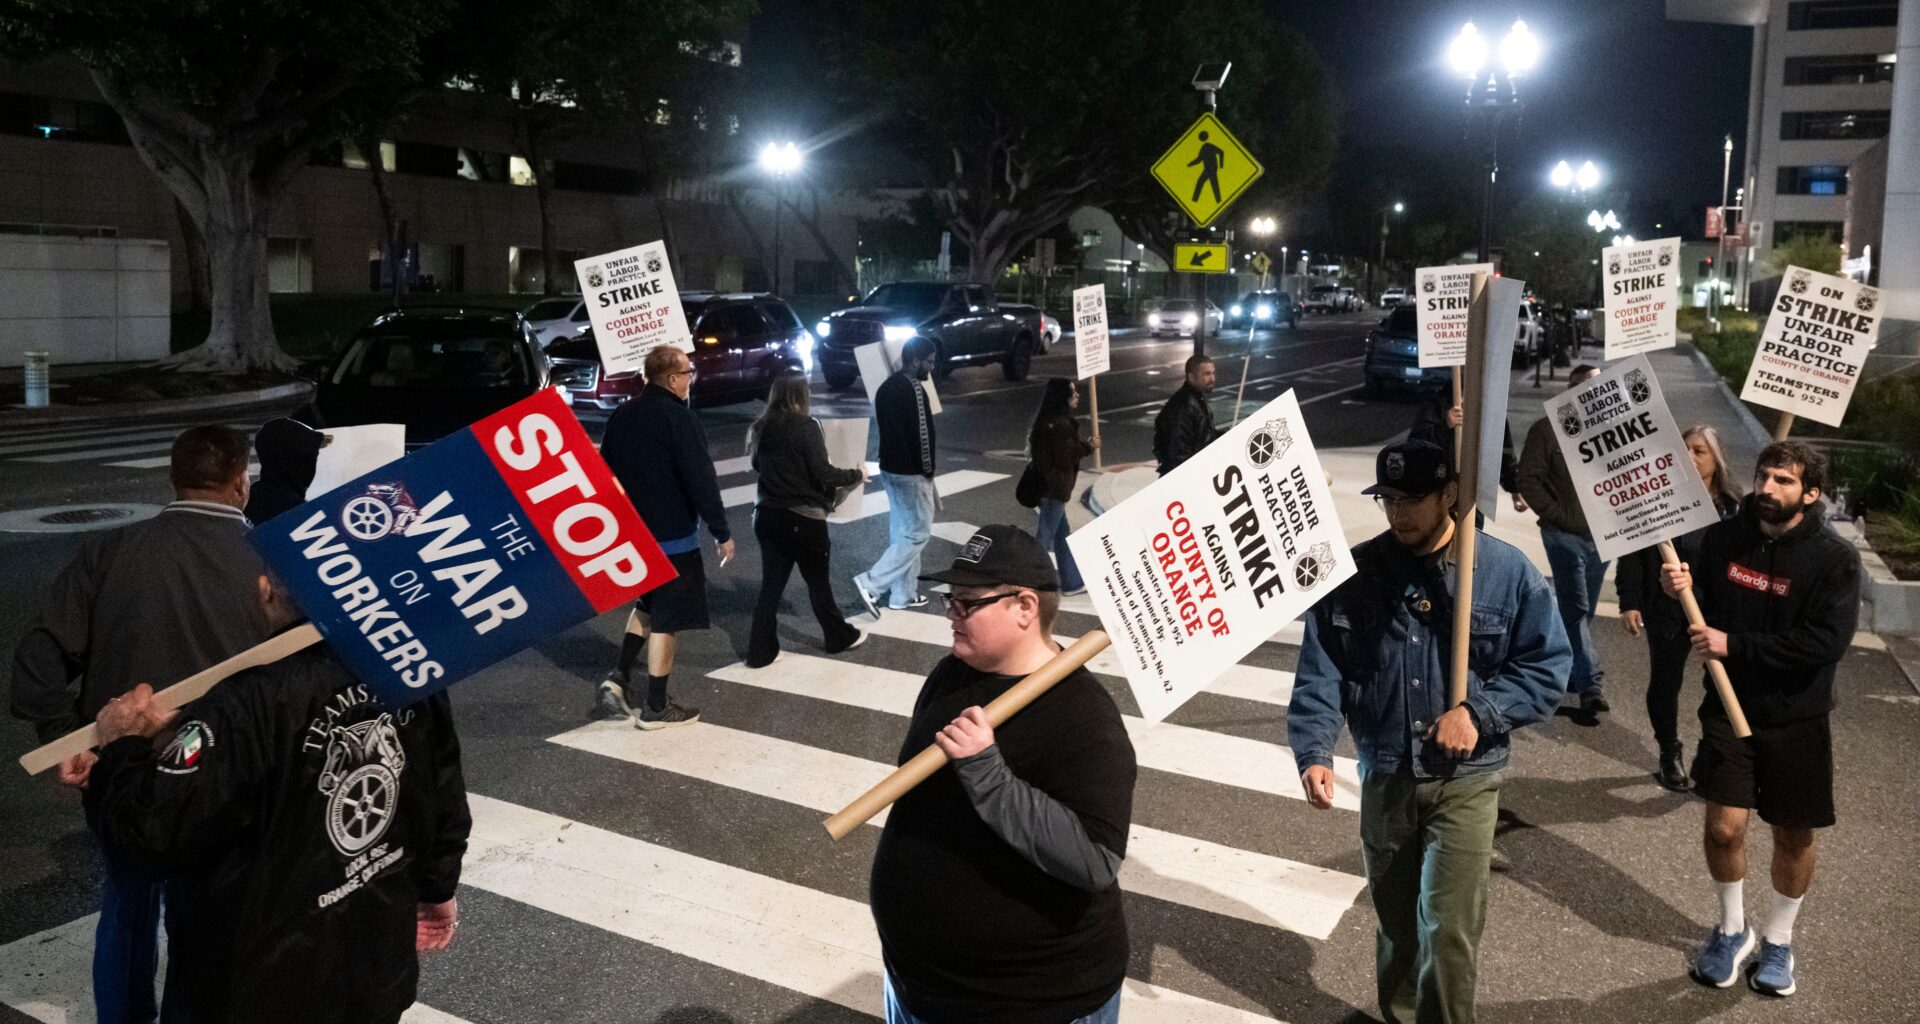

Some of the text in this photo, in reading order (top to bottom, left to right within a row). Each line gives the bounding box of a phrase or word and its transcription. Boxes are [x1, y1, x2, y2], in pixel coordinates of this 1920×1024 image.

[606, 256, 639, 269] UNFAIR
[1624, 264, 1656, 274] PRACTICE
[1628, 250, 1652, 259] UNFAIR
[1629, 258, 1650, 266] LABOR
[607, 272, 646, 286] PRACTICE
[610, 265, 640, 277] LABOR
[1614, 273, 1666, 296] STRIKE
[598, 279, 663, 308] STRIKE
[1428, 296, 1470, 311] STRIK
[1626, 294, 1652, 304] AGAINST
[1820, 287, 1844, 300] ON
[606, 306, 670, 331] COUNTY OF
[620, 302, 651, 316] AGAINST
[1079, 312, 1102, 328] STRIKE
[1614, 302, 1666, 319] COUNTY OF
[1621, 313, 1657, 328] ORANGE
[1776, 295, 1874, 334] STRIKE
[617, 319, 664, 339] ORANGE
[1434, 331, 1467, 339] ORANG
[1784, 316, 1855, 346] UNFAIR
[1779, 330, 1843, 358] LABOR
[1762, 341, 1858, 377] PRACTICE
[1762, 355, 1798, 369] COUNTY
[1813, 369, 1851, 385] ORANGE
[1578, 380, 1619, 404] UNFAIR
[1753, 380, 1824, 406] LOCAL 952
[1758, 370, 1840, 399] TEAMSTERS
[1584, 402, 1631, 429] PRACTICE
[1586, 393, 1622, 415] LABOR
[1578, 412, 1658, 464] STRIKE
[1593, 453, 1674, 497] COUNTY OF
[1606, 448, 1646, 473] AGAINST
[493, 412, 649, 588] STOP
[1290, 465, 1319, 531] UNFAIR
[1609, 474, 1671, 507] ORANGE
[1615, 489, 1674, 516] Teamsters Local 952
[1258, 473, 1296, 560] PRACTICE
[1277, 477, 1304, 537] LABOR
[1626, 502, 1670, 522] Sanctioned By:
[490, 513, 536, 561] THE
[1213, 465, 1285, 609] STRIKE
[1604, 531, 1618, 541] Joint
[1620, 523, 1640, 534] Council
[1648, 509, 1680, 524] Teamsters
[405, 490, 529, 636] WAR
[1166, 501, 1230, 639] COUNTY OF
[1202, 523, 1237, 592] AGAINST
[390, 569, 431, 606] ON
[1152, 532, 1204, 637] ORANGE
[1730, 566, 1786, 595] Beardgng
[289, 510, 445, 689] WORKERS
[1132, 570, 1166, 643] Sanctioned By:
[1138, 548, 1184, 646] Teamsters Local 952
[1100, 534, 1173, 694] Joint Council of Teamsters No. 42
[1104, 576, 1148, 670] www.Teamsters952.org
